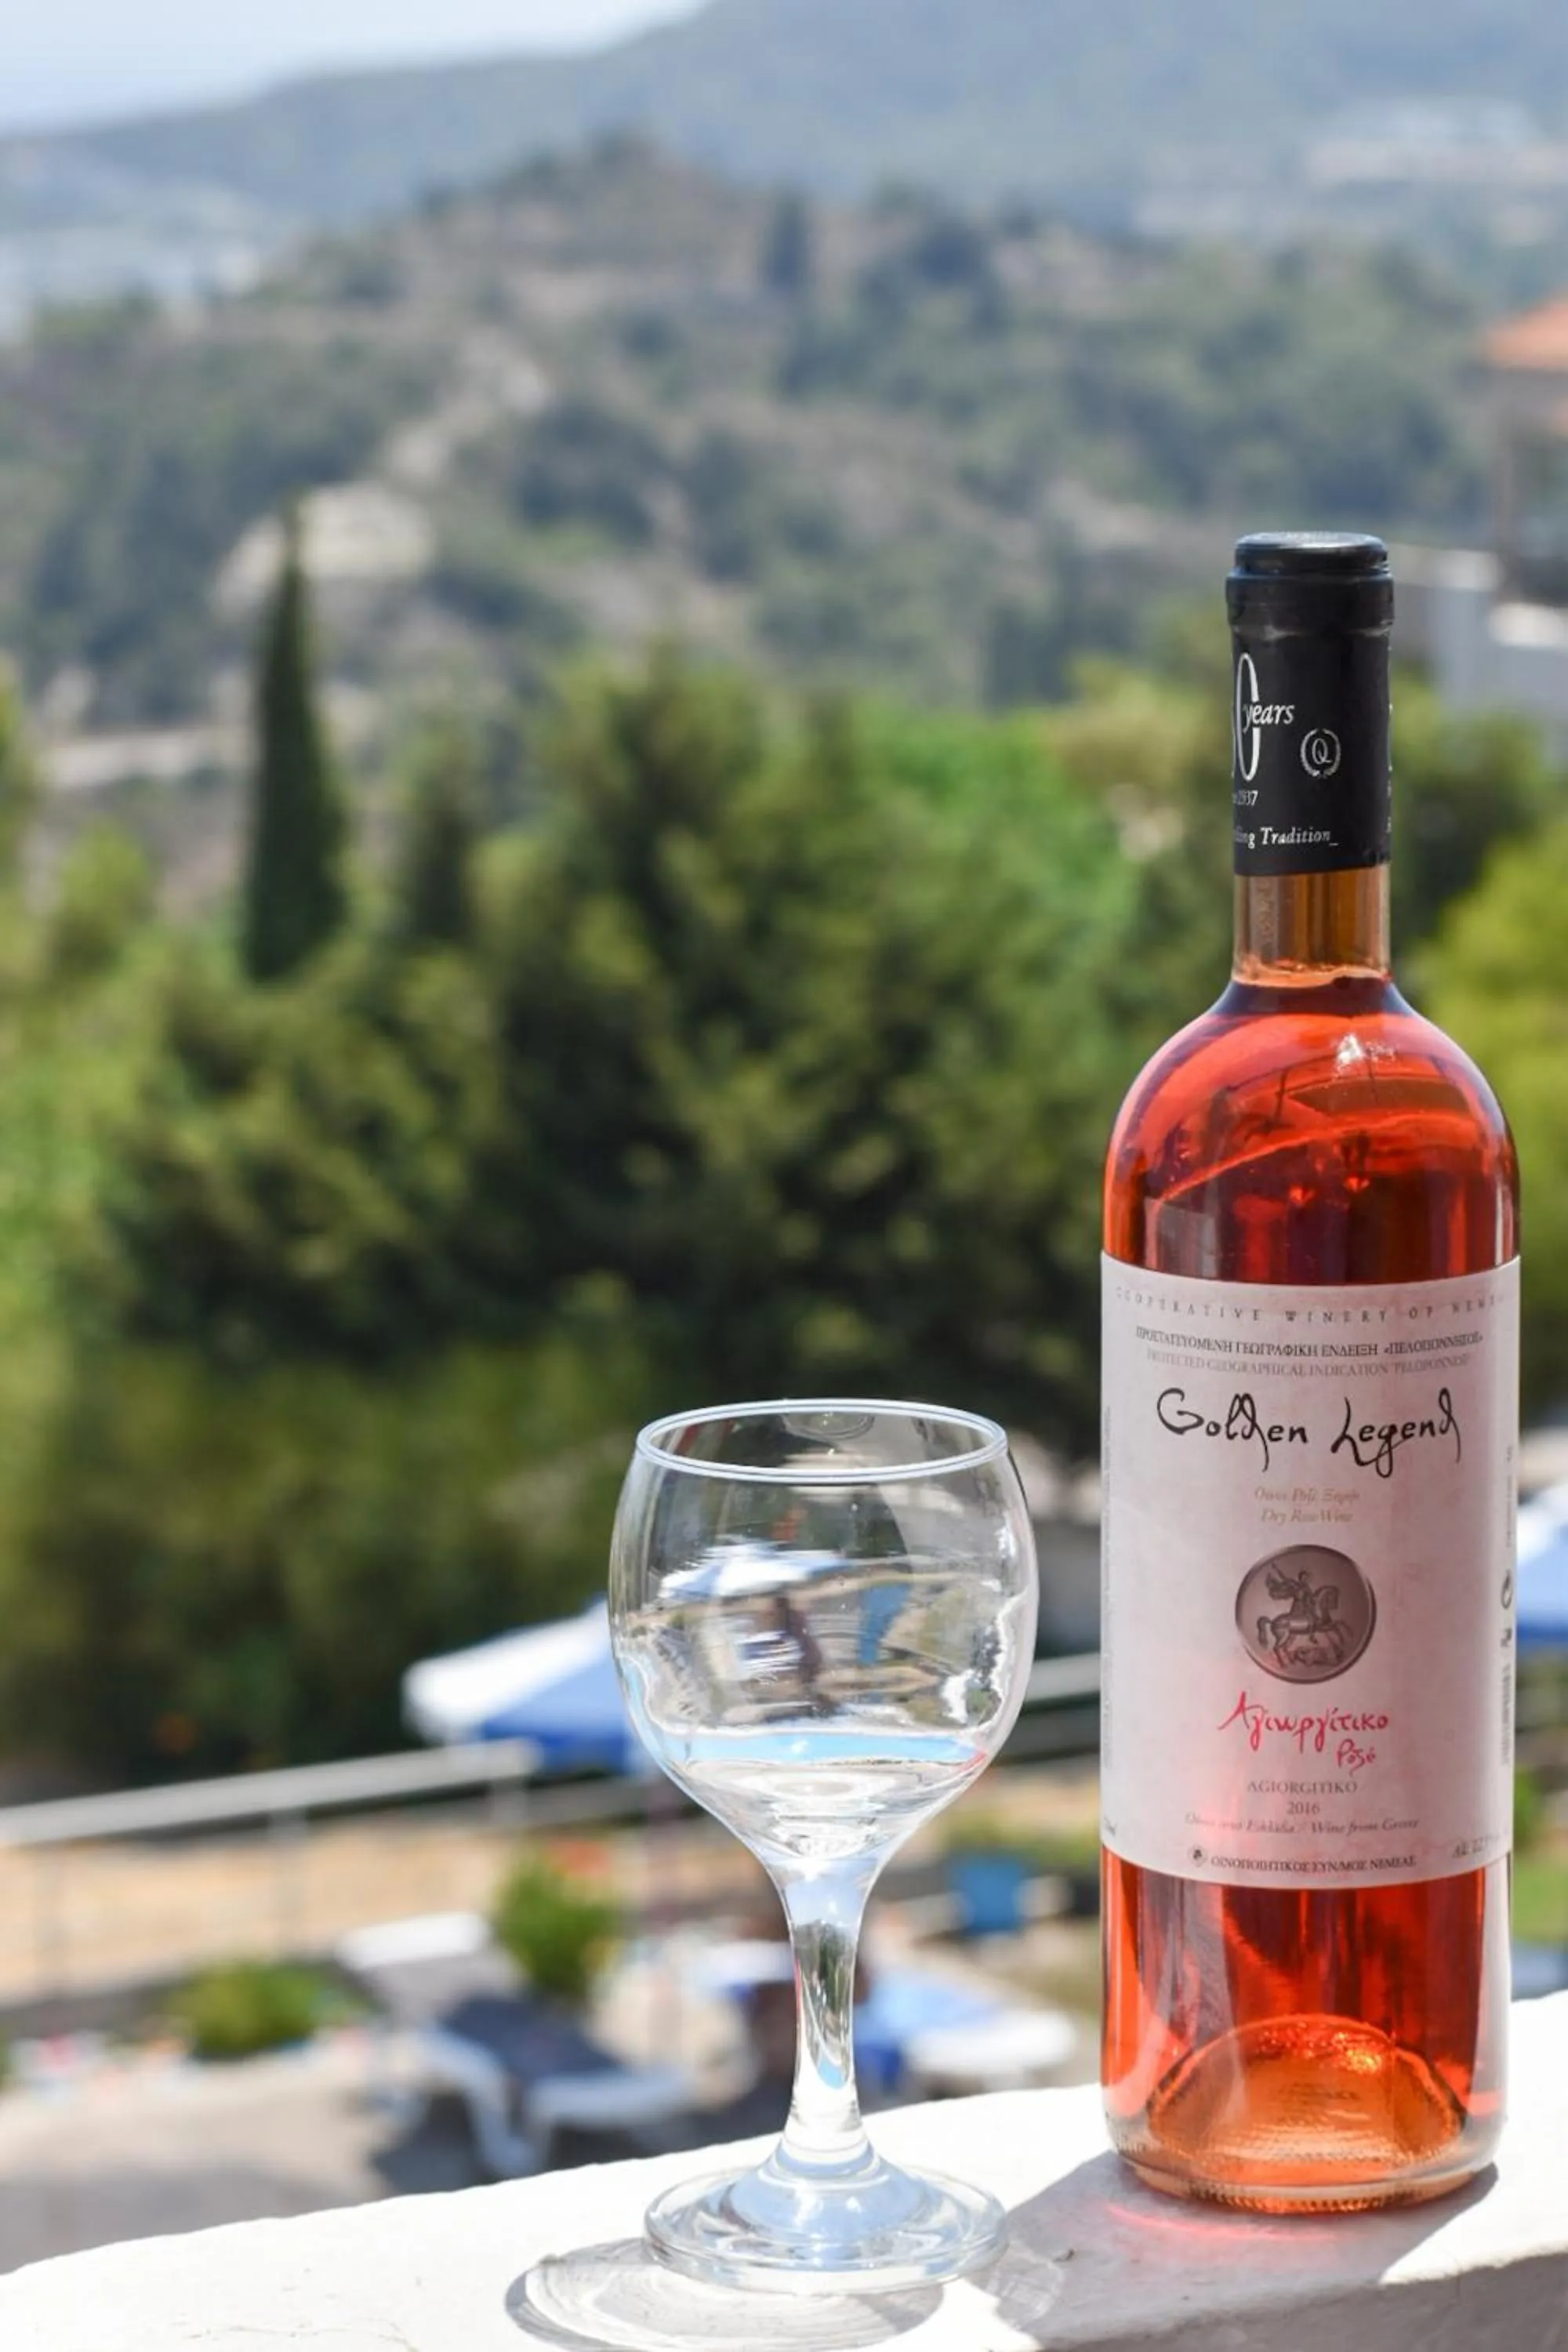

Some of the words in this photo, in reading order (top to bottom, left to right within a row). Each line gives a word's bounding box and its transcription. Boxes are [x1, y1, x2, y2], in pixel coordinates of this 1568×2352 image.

[1243, 704, 1294, 733] years
[1286, 1307, 1387, 1323] WINERY
[1409, 1306, 1434, 1320] OF
[1322, 1344, 1377, 1357] ΕΝΔΕΙΞΗ
[1309, 1361, 1388, 1377] INDICATION
[1157, 1388, 1308, 1472] Golden
[1330, 1388, 1461, 1478] Legend
[1247, 1780, 1358, 1795] AGIORGITIKO
[1287, 1801, 1320, 1815] 2016
